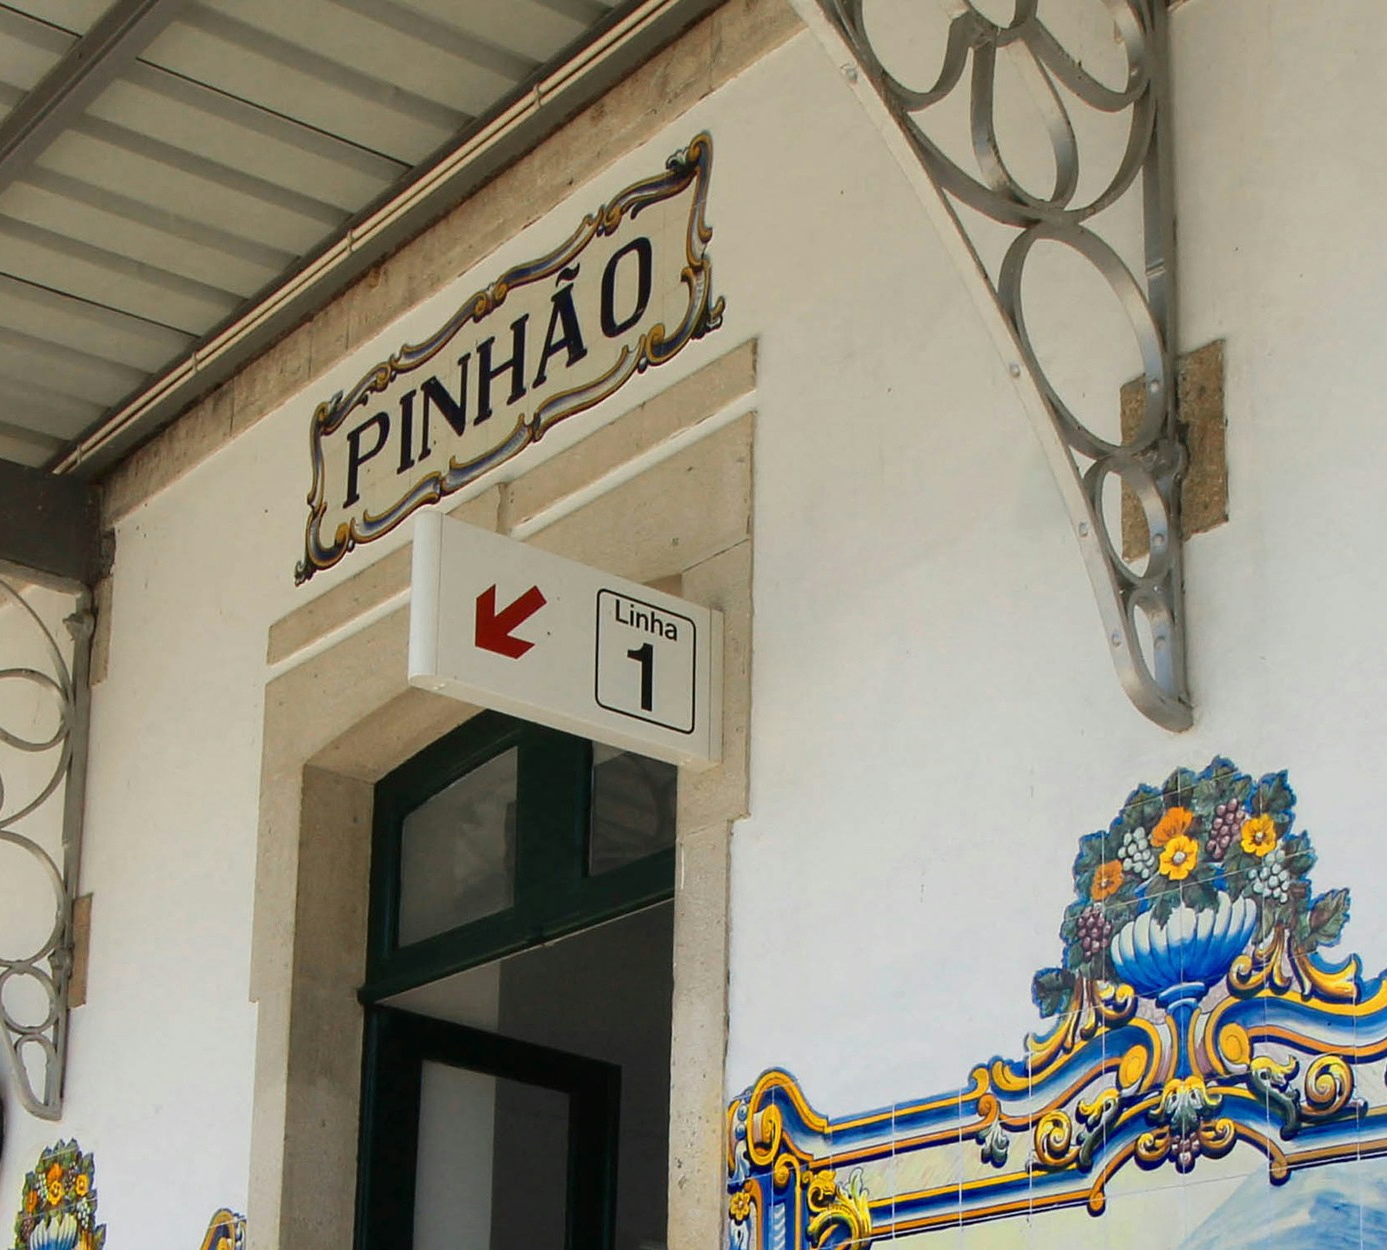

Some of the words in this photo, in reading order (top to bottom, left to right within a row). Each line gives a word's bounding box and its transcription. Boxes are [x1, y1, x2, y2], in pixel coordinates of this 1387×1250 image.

[342, 236, 653, 510] PINHÃO
[614, 598, 679, 642] Linha
[627, 643, 654, 712] 1
